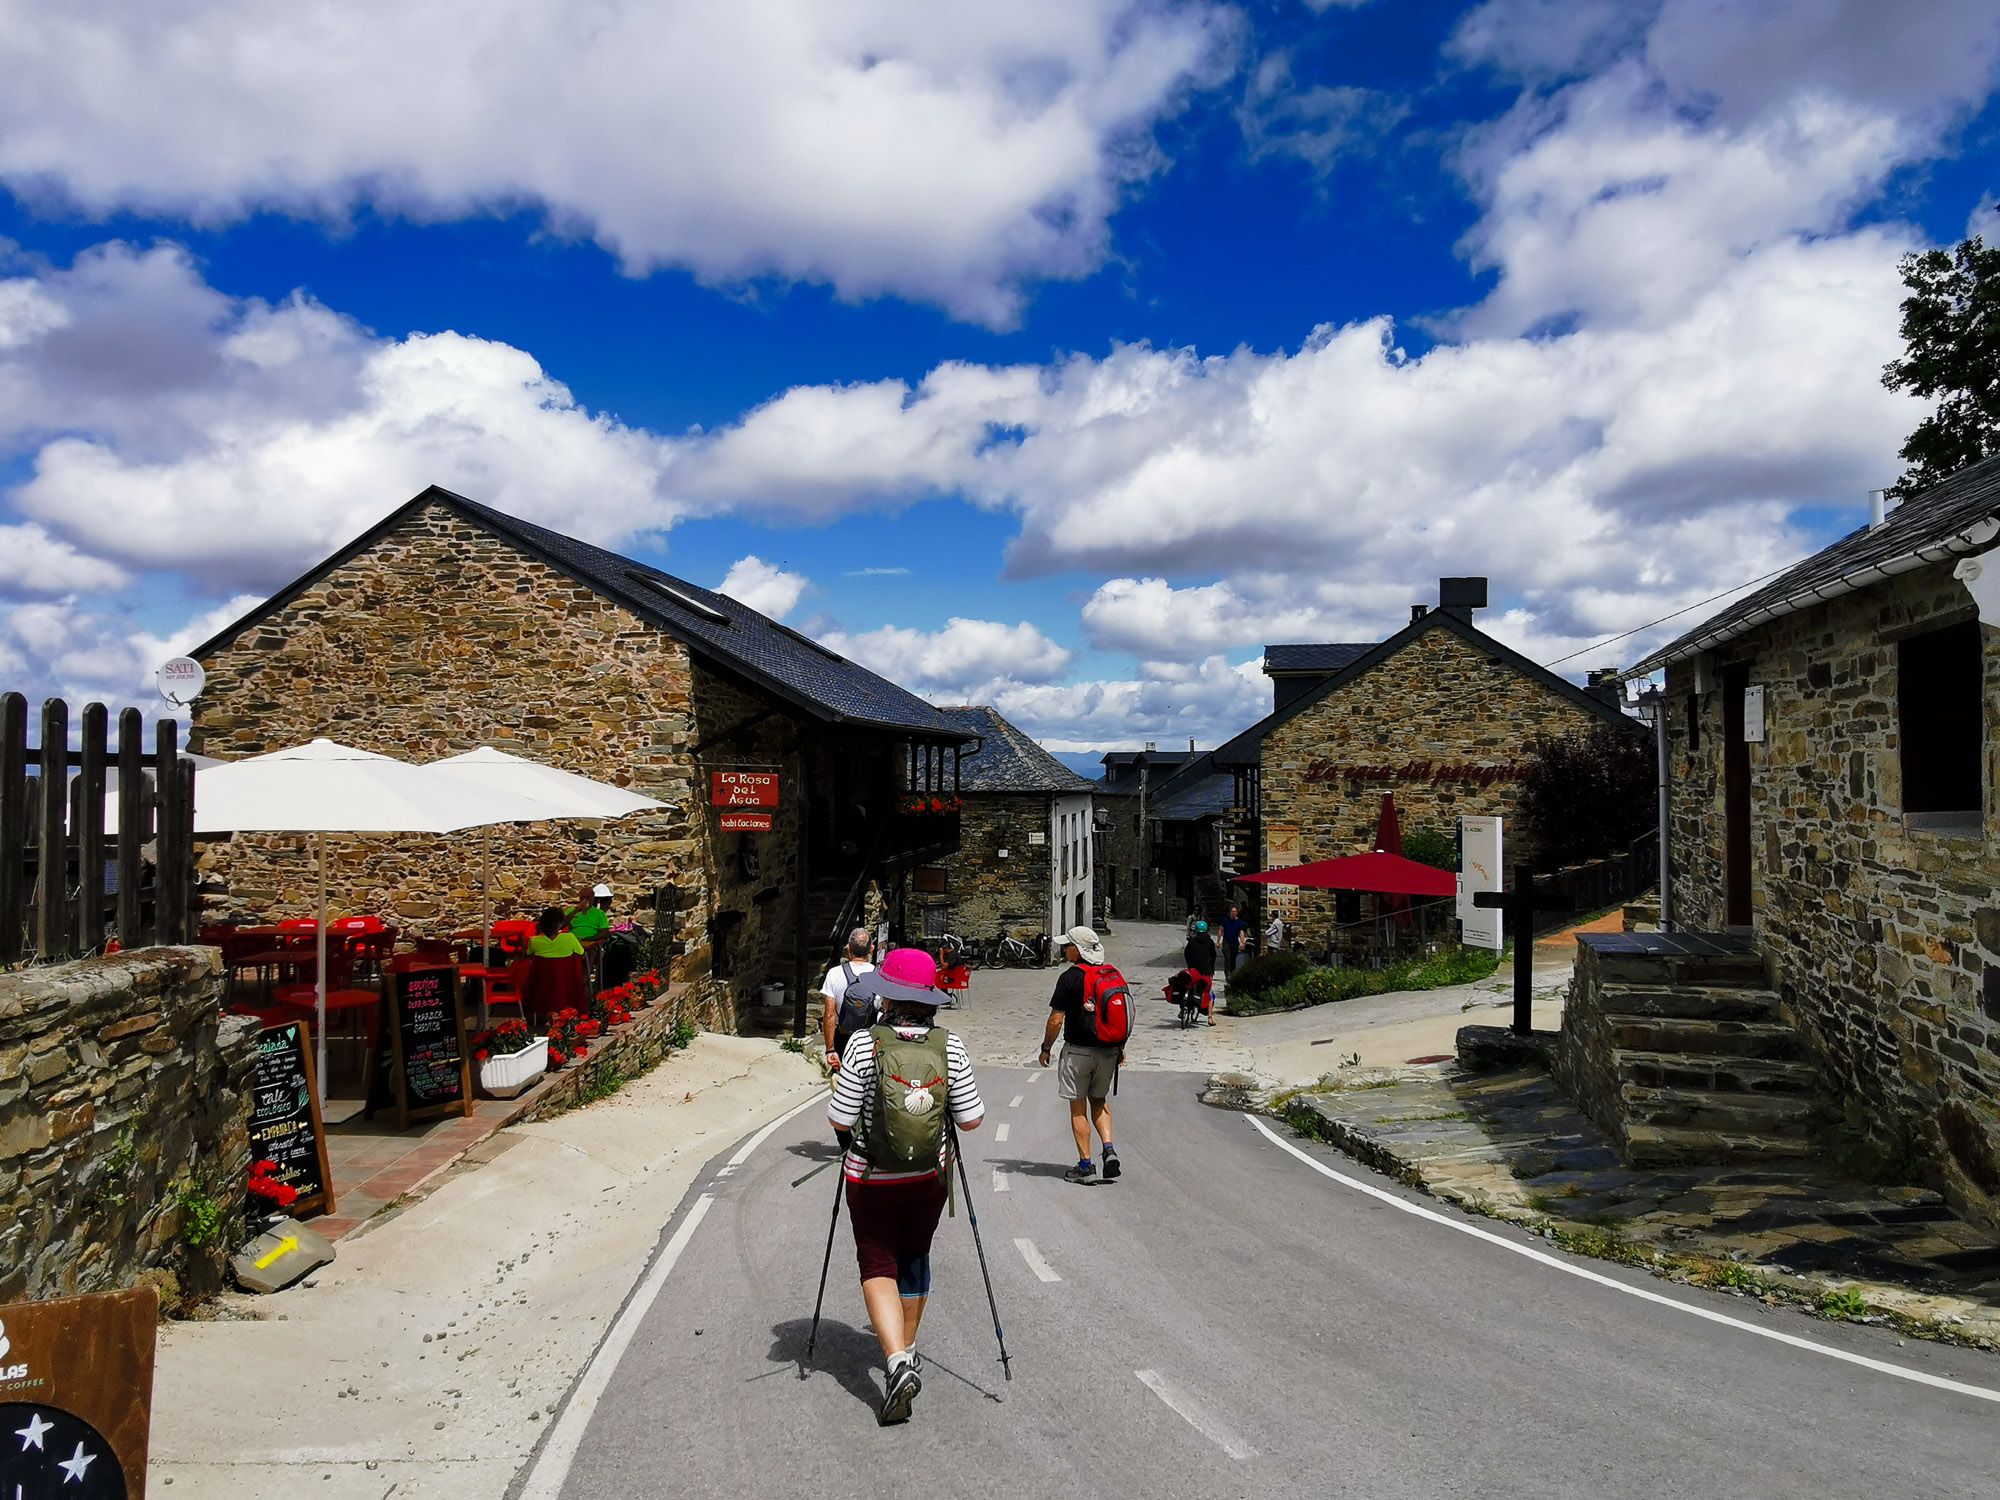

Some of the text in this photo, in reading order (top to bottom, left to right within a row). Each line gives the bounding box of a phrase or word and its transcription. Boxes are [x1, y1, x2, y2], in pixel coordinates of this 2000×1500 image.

[721, 773, 770, 785] La Rosa
[733, 785, 756, 794] del
[6, 1378, 44, 1391] COFFEE
